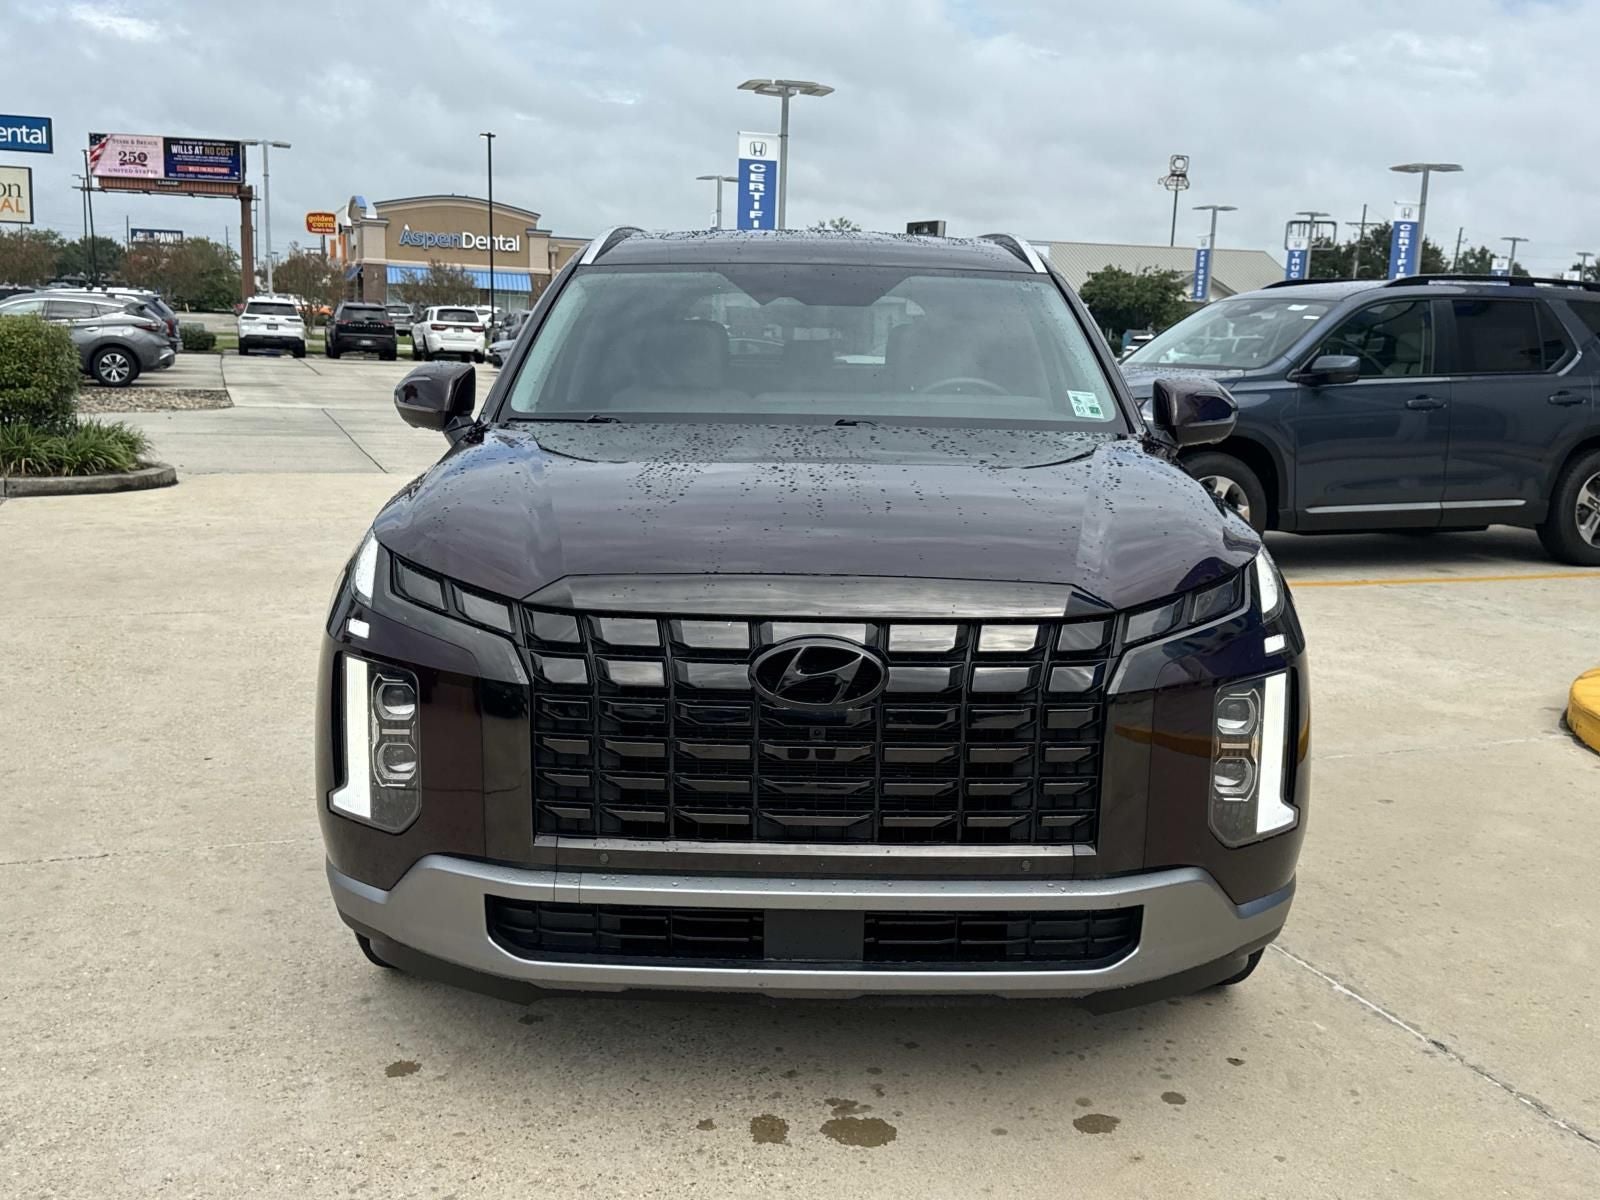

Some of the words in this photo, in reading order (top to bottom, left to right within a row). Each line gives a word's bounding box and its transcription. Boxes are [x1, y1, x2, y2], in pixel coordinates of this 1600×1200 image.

[0, 124, 47, 145] ental
[118, 150, 148, 163] 250
[170, 144, 193, 155] WILLS
[194, 145, 204, 155] AT
[204, 146, 215, 156] NO
[215, 147, 235, 157] COST
[749, 163, 767, 229] CERTIFI
[307, 214, 334, 223] golden
